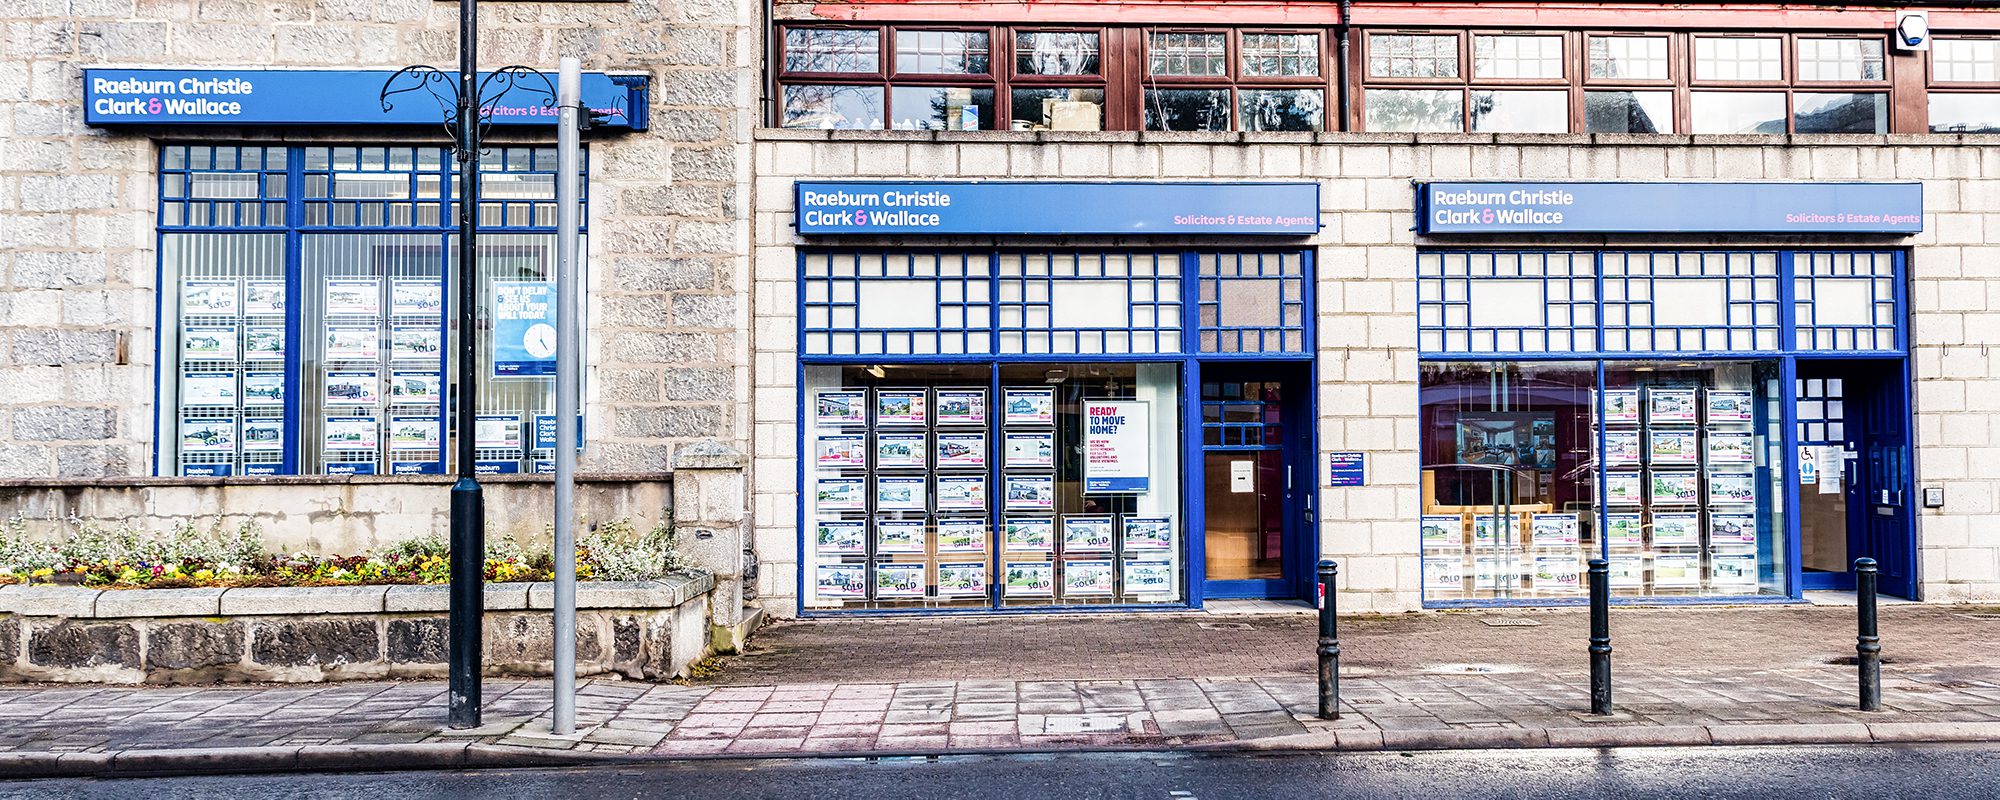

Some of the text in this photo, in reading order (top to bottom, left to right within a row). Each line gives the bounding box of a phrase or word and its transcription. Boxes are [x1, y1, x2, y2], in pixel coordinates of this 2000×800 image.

[93, 77, 253, 94] Raeburn Christie
[94, 97, 241, 114] Clark & Wallace
[529, 105, 538, 116] &
[540, 106, 559, 116] Est
[804, 190, 951, 206] Raeburn Christie
[1434, 189, 1574, 205] Raeburn Christie
[805, 209, 940, 226] Clark & Wallace
[1174, 214, 1315, 227] Solicitors & Estate Agents
[1435, 208, 1564, 224] Clark & Wallace
[1785, 213, 1920, 225] Solicitors & Estate Agents
[522, 286, 548, 295] DELAY
[504, 295, 519, 303] SEE
[520, 295, 531, 303] US
[417, 300, 440, 309] SOLD
[497, 303, 548, 311] ABOUT YOUR
[498, 311, 518, 319] WILL
[413, 344, 437, 353] SOLD
[346, 390, 369, 400] SOLD
[1089, 406, 1118, 416] READY
[1089, 416, 1126, 425] TO MOVE
[1089, 425, 1118, 435] HOME?
[1675, 489, 1697, 499] SOLD
[1087, 536, 1109, 546] SOLD
[1074, 578, 1096, 588] SOLD
[1142, 577, 1164, 585] SOLD
[1439, 574, 1460, 583] SOLD
[1556, 573, 1577, 583] SOLD
[841, 582, 864, 592] SOLD
[894, 581, 917, 592] SOLD
[958, 580, 980, 590] SOLD
[1027, 580, 1050, 590] SOLD
